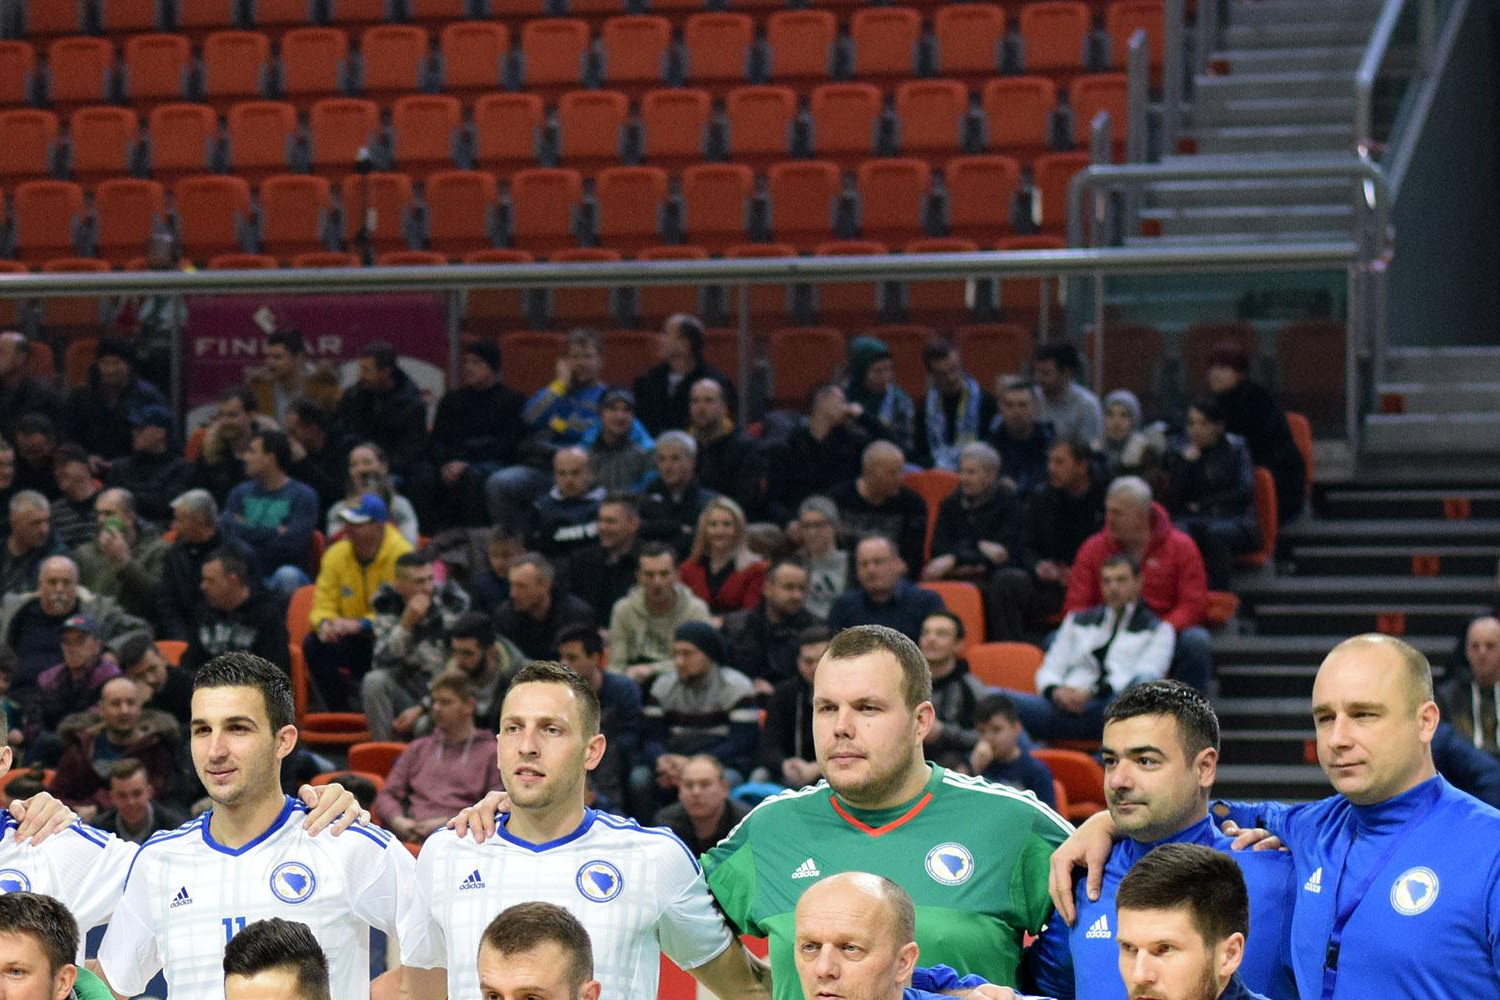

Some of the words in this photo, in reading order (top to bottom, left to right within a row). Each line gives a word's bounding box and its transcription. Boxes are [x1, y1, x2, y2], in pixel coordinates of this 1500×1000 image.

[791, 870, 820, 879] adidas
[459, 881, 486, 890] adidas
[170, 898, 193, 908] adidas
[1085, 929, 1112, 939] adidas
